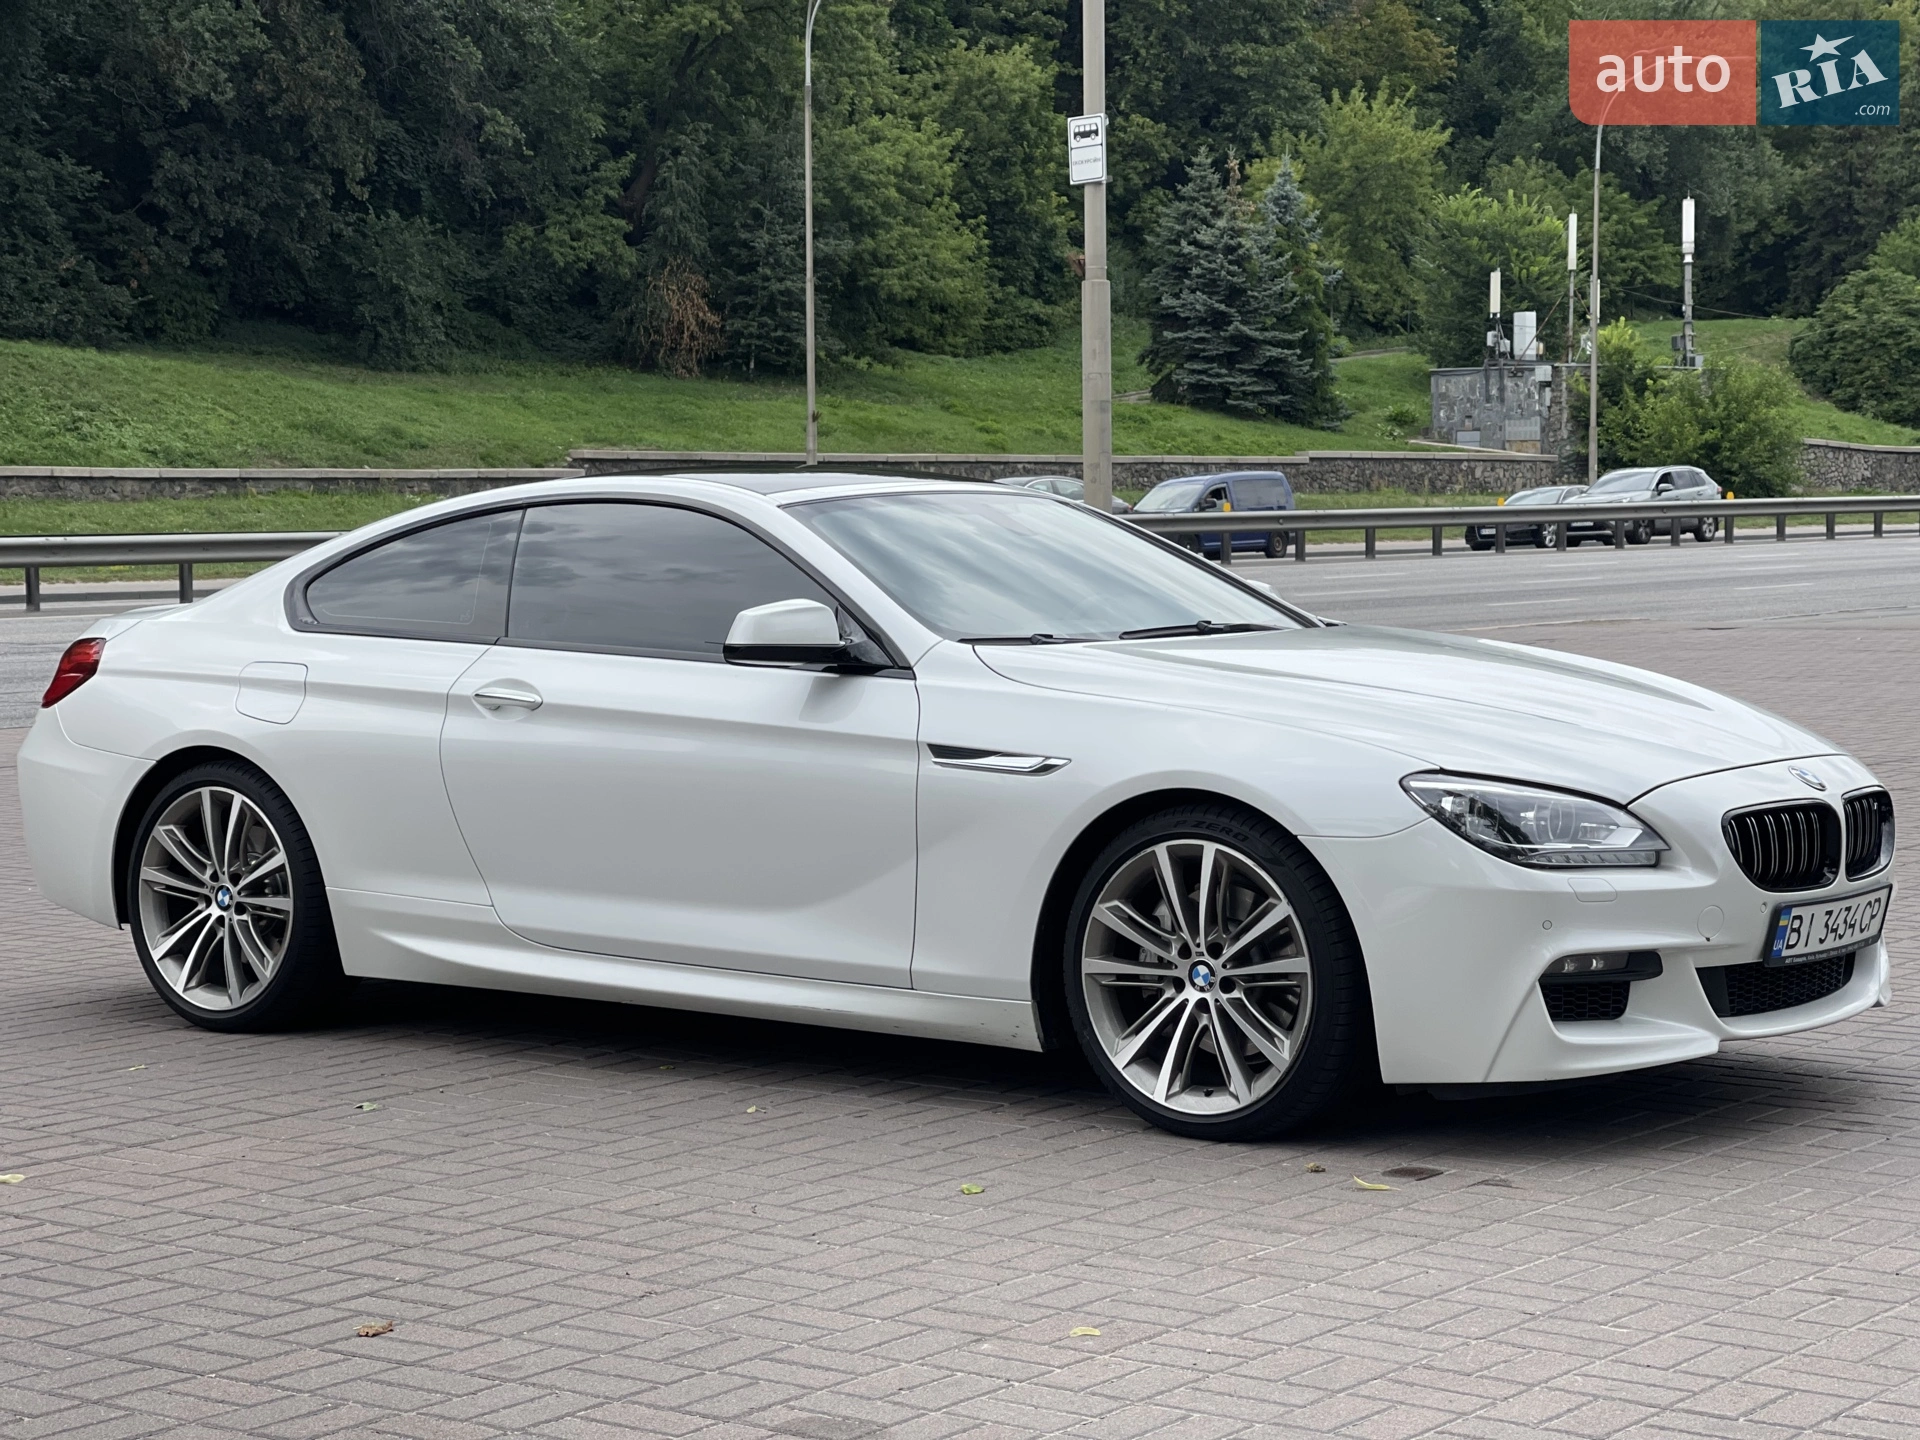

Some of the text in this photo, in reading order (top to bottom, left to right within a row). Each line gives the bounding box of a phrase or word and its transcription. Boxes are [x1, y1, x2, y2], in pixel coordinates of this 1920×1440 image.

[1190, 820, 1250, 843] ZERO
[1785, 912, 1815, 950] BI
[1818, 903, 1861, 945] 3434
[1859, 897, 1882, 934] CP
[1773, 939, 1783, 950] UA
